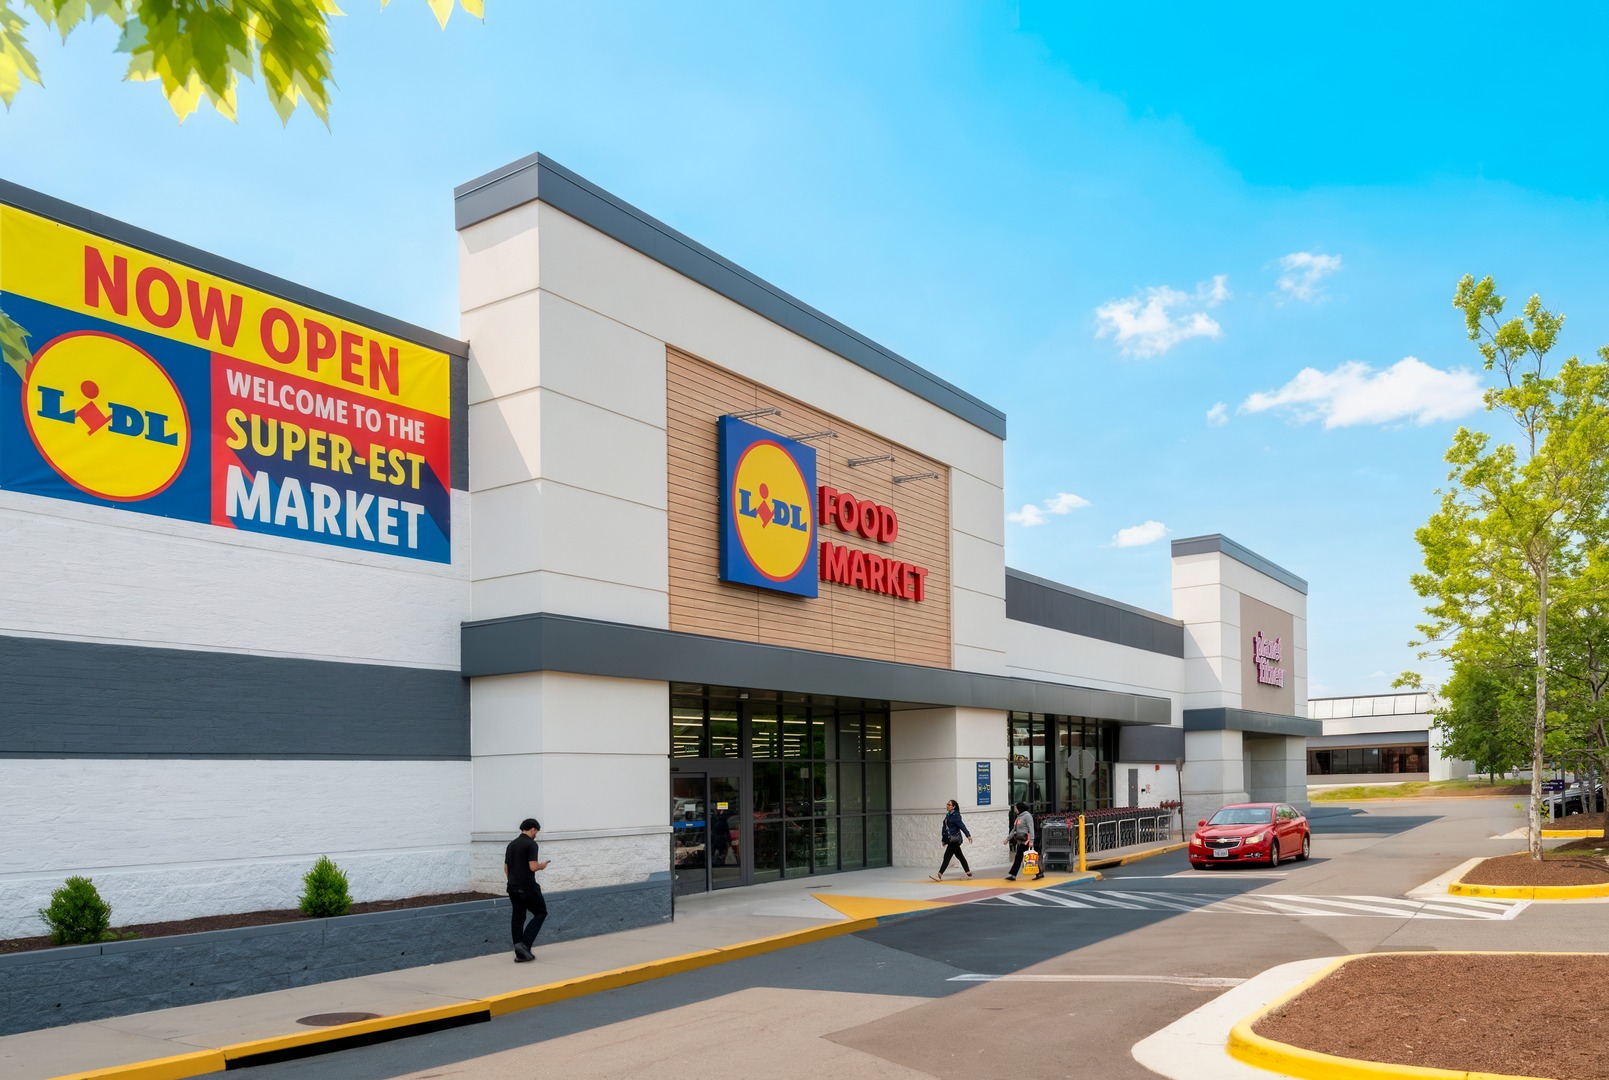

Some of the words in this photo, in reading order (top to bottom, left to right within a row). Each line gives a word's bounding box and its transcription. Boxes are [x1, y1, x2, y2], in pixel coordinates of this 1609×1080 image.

[84, 245, 243, 348] NOW
[260, 308, 400, 397] OPEN
[226, 369, 348, 424] WELCOME
[353, 405, 381, 433] TO
[386, 413, 425, 445] THE
[225, 409, 425, 489] SUPER-EST
[225, 465, 425, 549] MARKET
[818, 485, 898, 543] FOOD
[820, 541, 928, 602] MARKET
